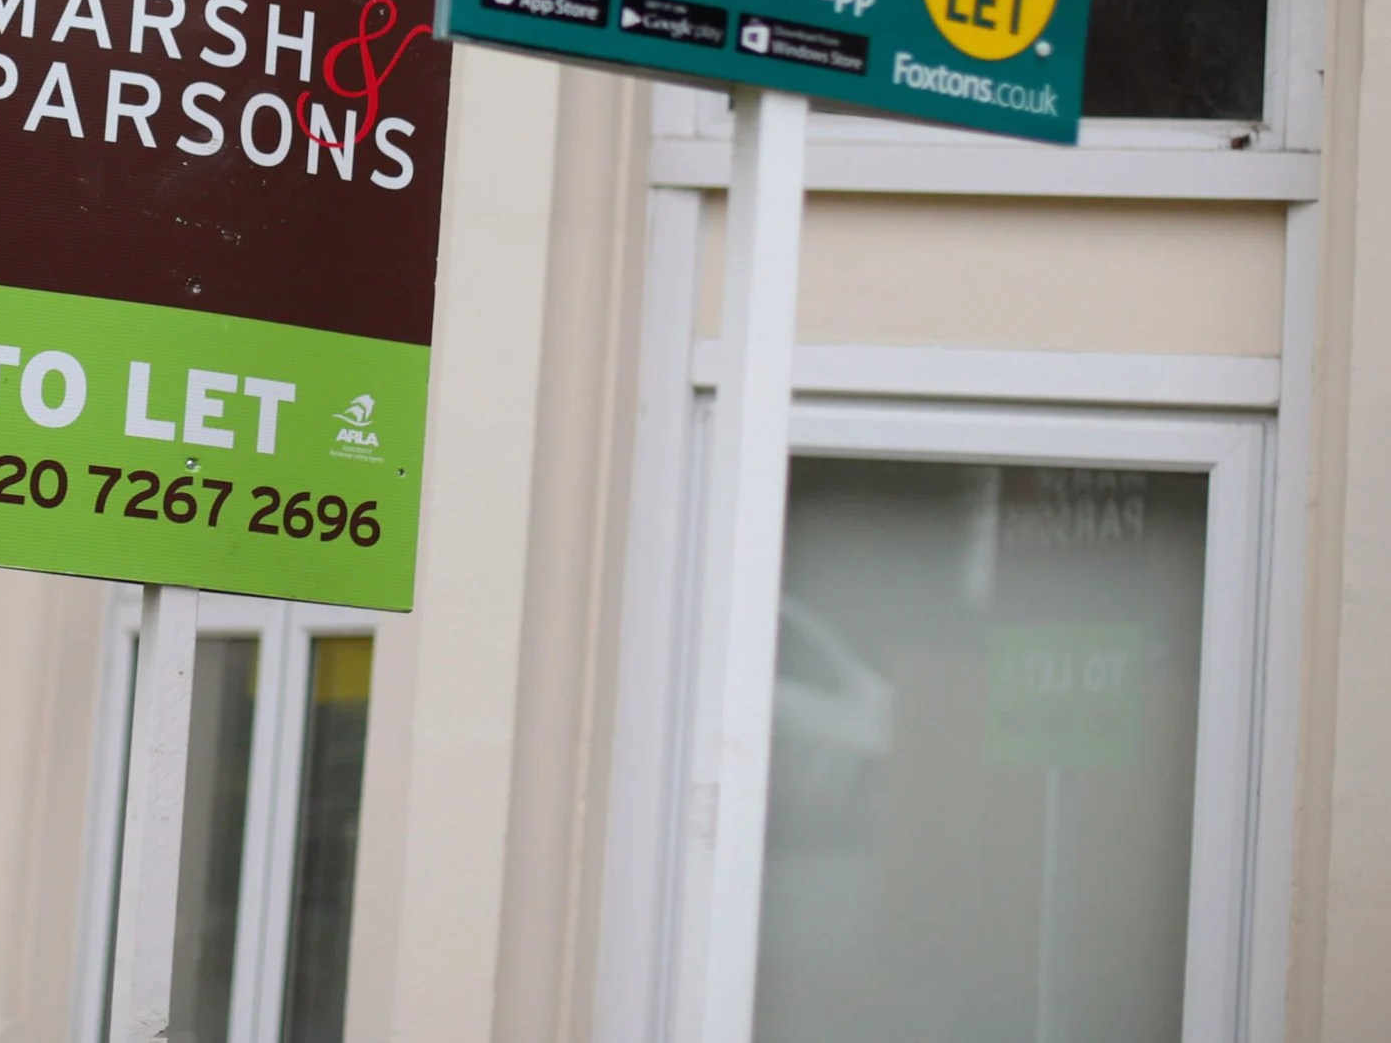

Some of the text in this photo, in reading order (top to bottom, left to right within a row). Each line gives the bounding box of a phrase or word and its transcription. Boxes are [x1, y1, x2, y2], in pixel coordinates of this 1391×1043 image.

[892, 51, 1058, 116] Foxtons.co.uk
[123, 360, 296, 455] LET
[336, 428, 379, 447] ARLA
[88, 464, 233, 527] 7267
[248, 486, 382, 547] 2696
